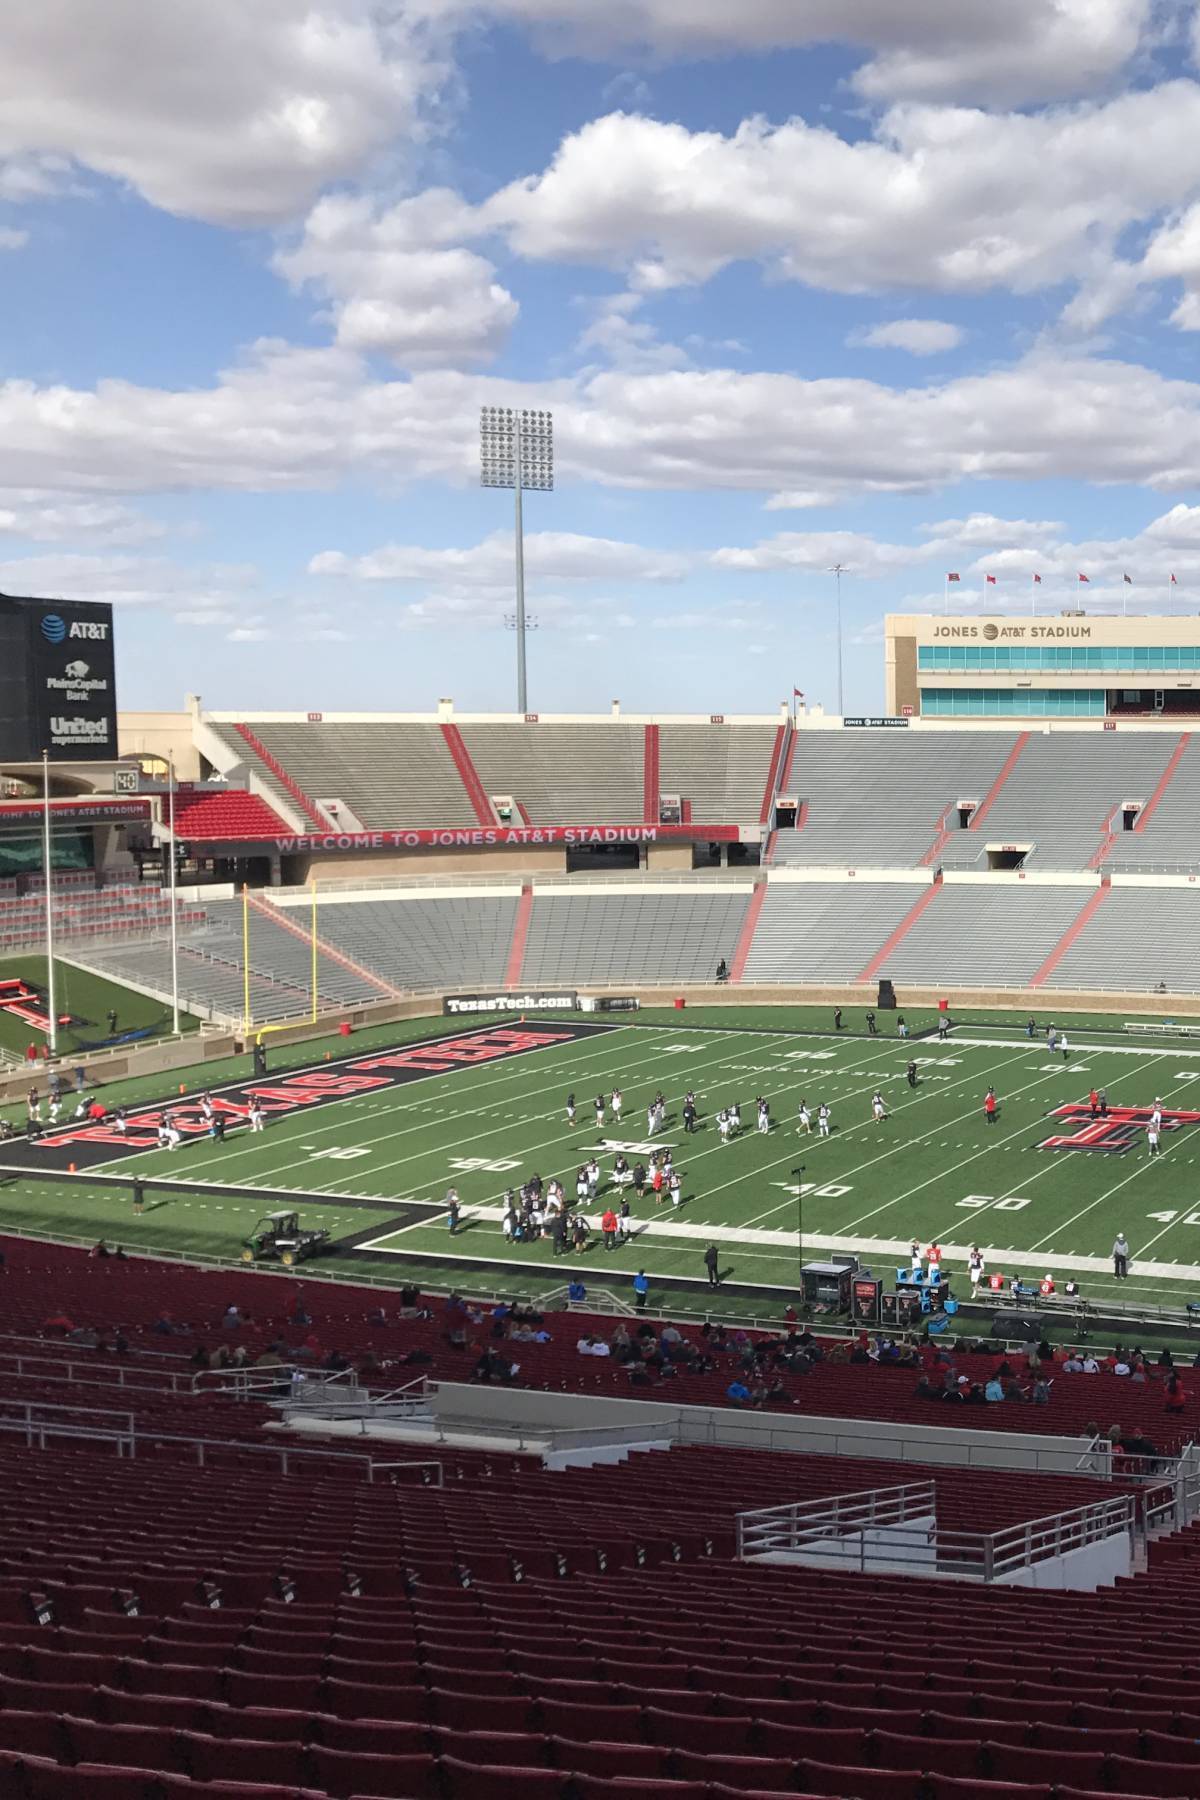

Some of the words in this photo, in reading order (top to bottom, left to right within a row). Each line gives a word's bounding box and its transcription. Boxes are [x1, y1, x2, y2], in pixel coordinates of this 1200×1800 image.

[69, 621, 109, 640] AT&T
[933, 626, 978, 638] JONES
[1000, 626, 1027, 638] AT&T
[1030, 626, 1091, 638] STADIUM
[47, 677, 107, 691] PlainsCapital
[66, 690, 89, 701] Bank
[50, 717, 108, 735] United
[104, 805, 144, 815] STADIUM
[275, 833, 384, 851] WELCOME
[391, 833, 419, 847] TO
[428, 830, 497, 847] JONES
[505, 829, 556, 844] AT&T
[563, 828, 657, 843] STADIUM
[447, 995, 573, 1013] TexasTech.com
[30, 1072, 395, 1149] TEXAS
[346, 1029, 576, 1071] TECH
[780, 1182, 854, 1198] 40
[954, 1194, 1032, 1211] 50
